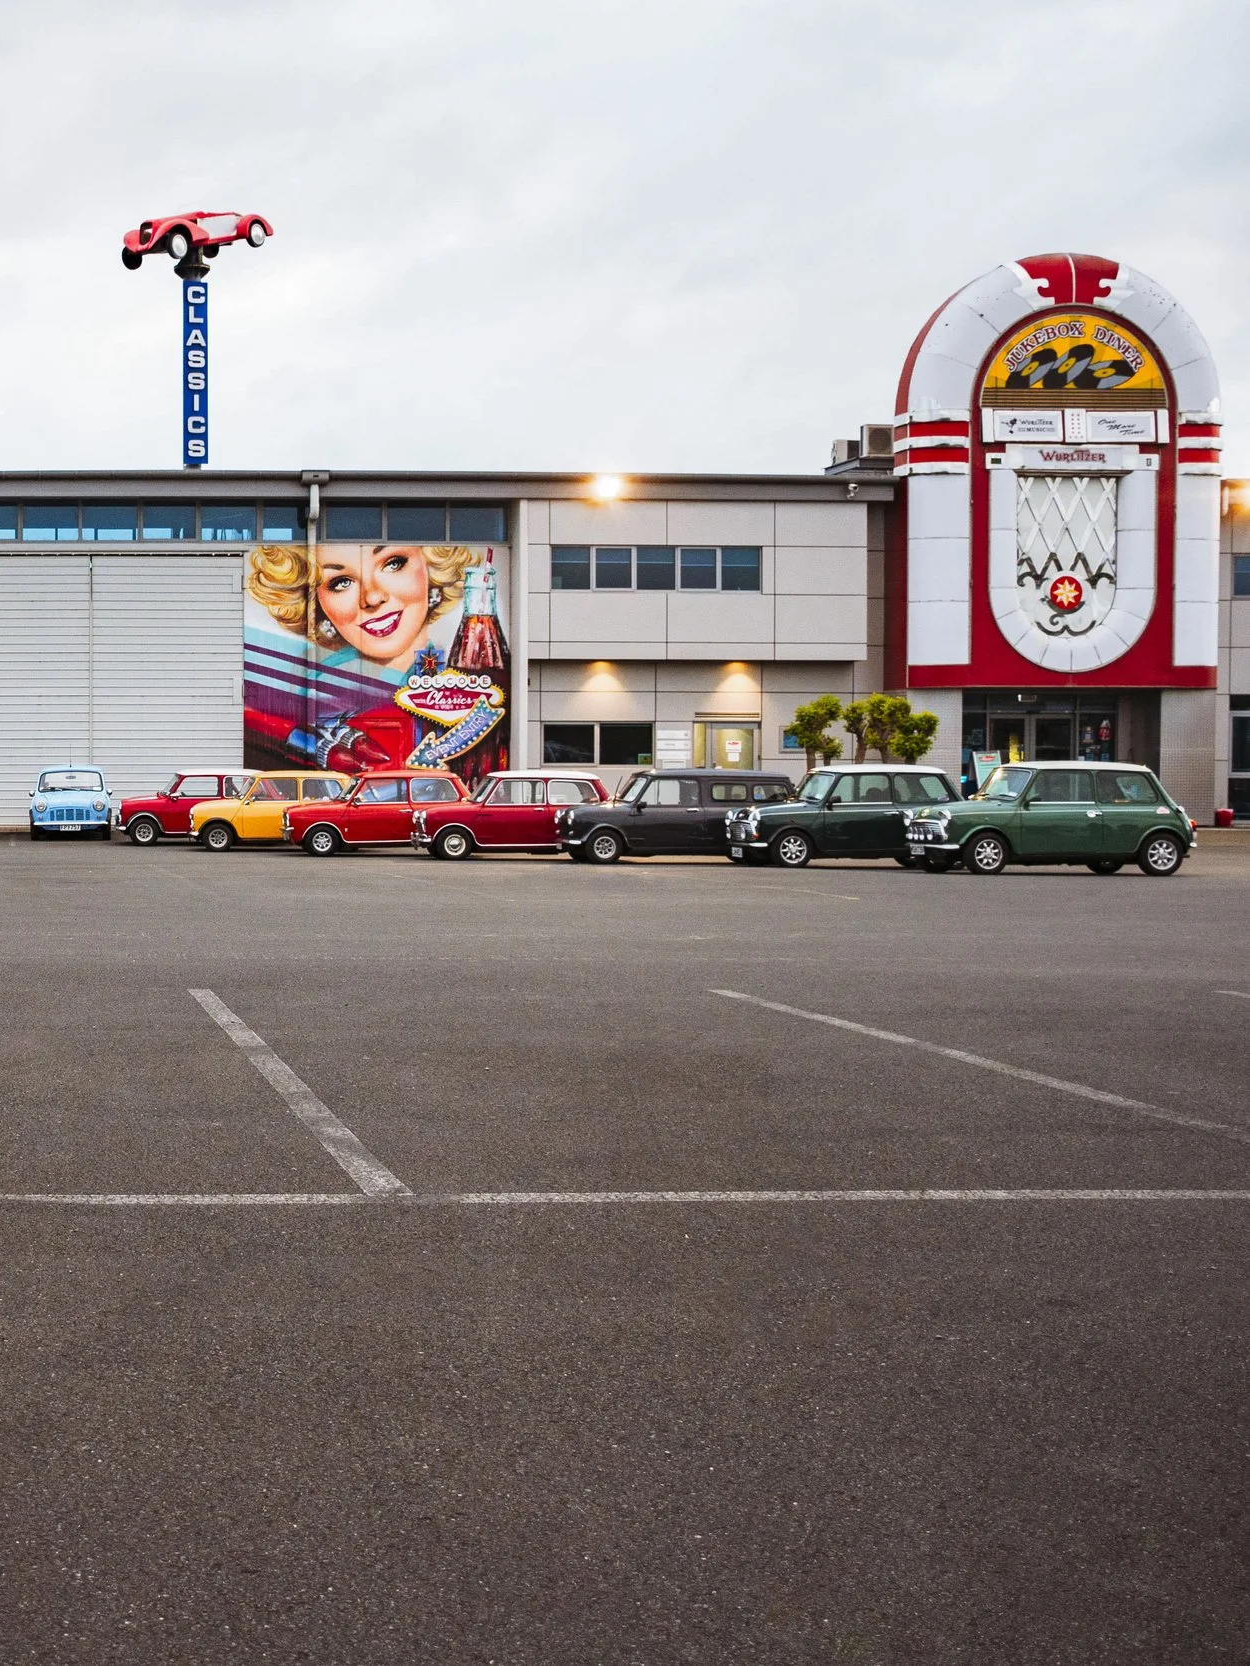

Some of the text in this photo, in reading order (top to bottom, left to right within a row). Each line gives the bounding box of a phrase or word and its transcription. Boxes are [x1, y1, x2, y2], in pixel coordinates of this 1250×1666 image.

[186, 285, 207, 458] CLASSICS
[1005, 323, 1144, 372] JUKEBOX DINER
[410, 676, 489, 687] WELCOME
[426, 690, 472, 705] Classics
[425, 709, 488, 760] EVENT ENTRY
